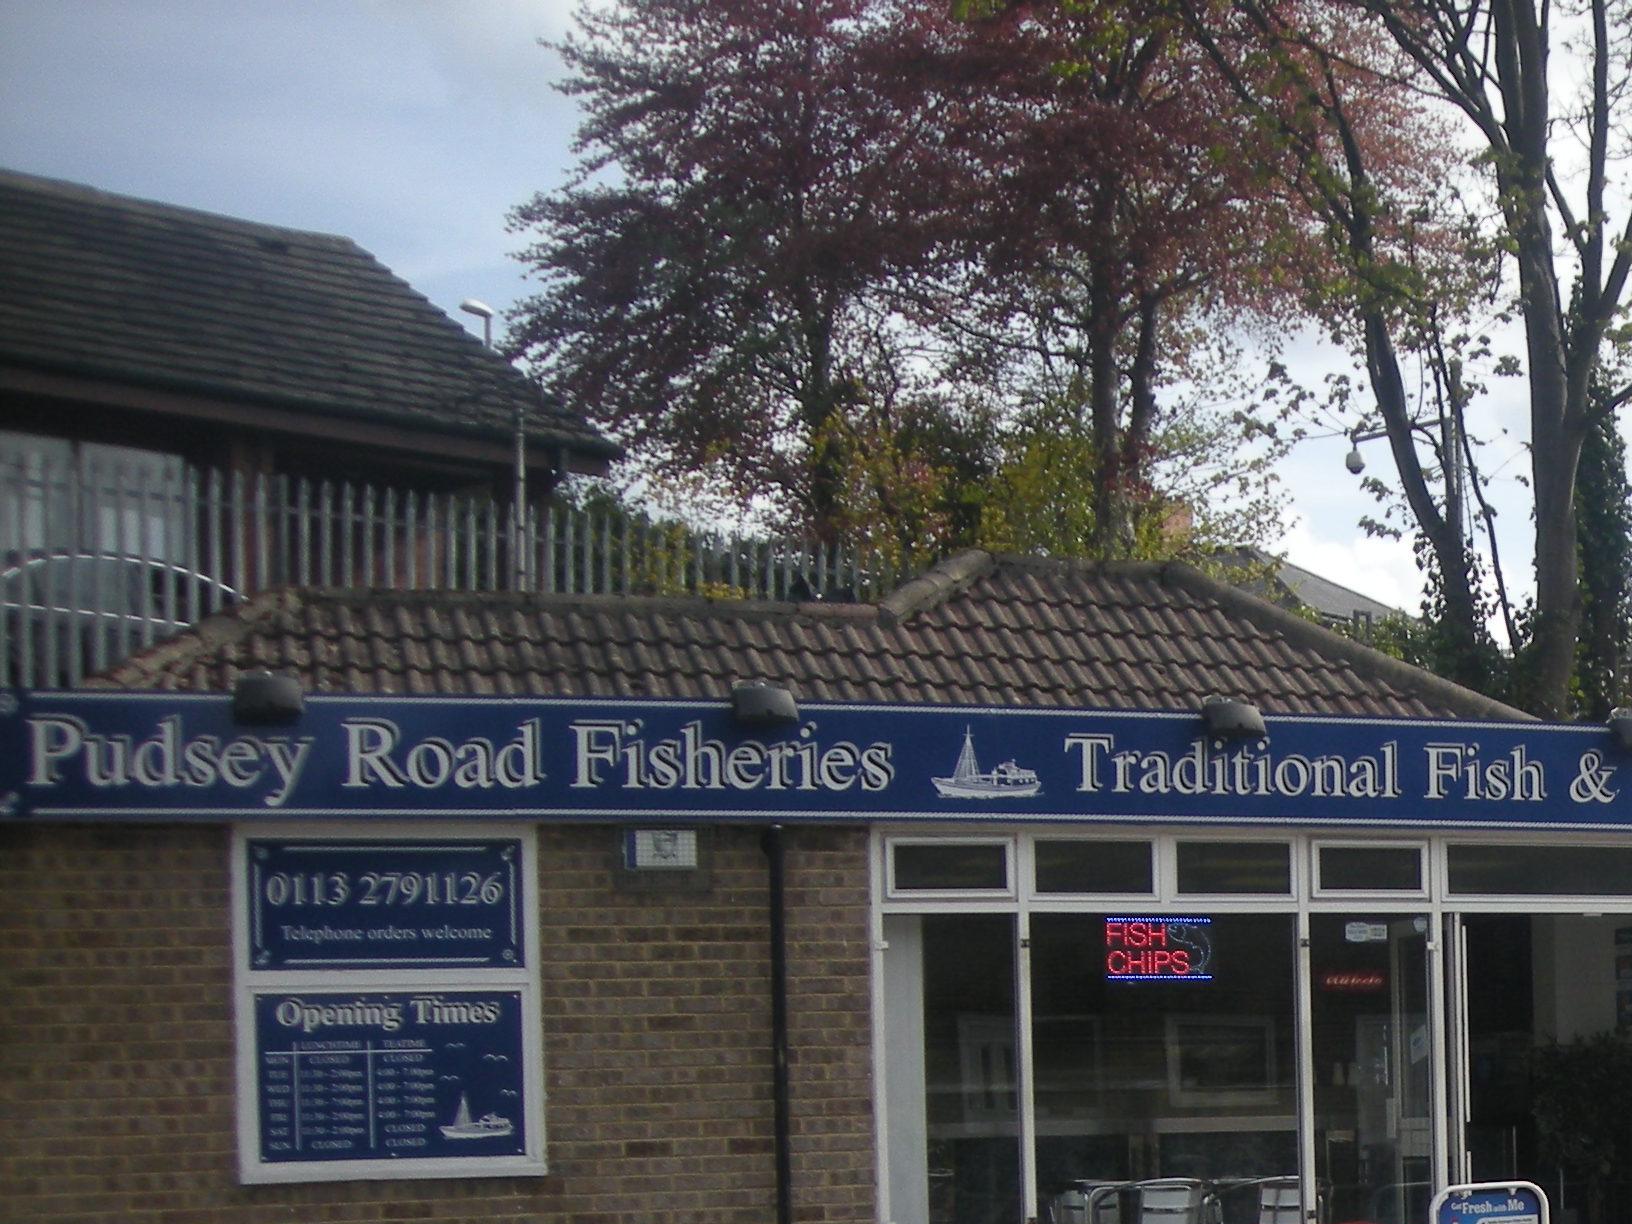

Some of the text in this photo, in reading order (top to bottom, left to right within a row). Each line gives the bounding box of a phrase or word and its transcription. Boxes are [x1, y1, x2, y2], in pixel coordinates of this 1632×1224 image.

[26, 709, 894, 806] Pudsey Road Fisheries
[1063, 730, 1402, 801] Traditional
[1423, 740, 1547, 803] Fish
[1567, 746, 1619, 805] &
[266, 871, 503, 906] 0113 2791126
[281, 924, 493, 944] Telephone orders welcome
[1106, 922, 1167, 947] FISH
[1106, 950, 1190, 975] CHIPS
[276, 995, 501, 1032] Opening Times
[1462, 1200, 1493, 1215] Fresh
[1507, 1198, 1525, 1212] Me
